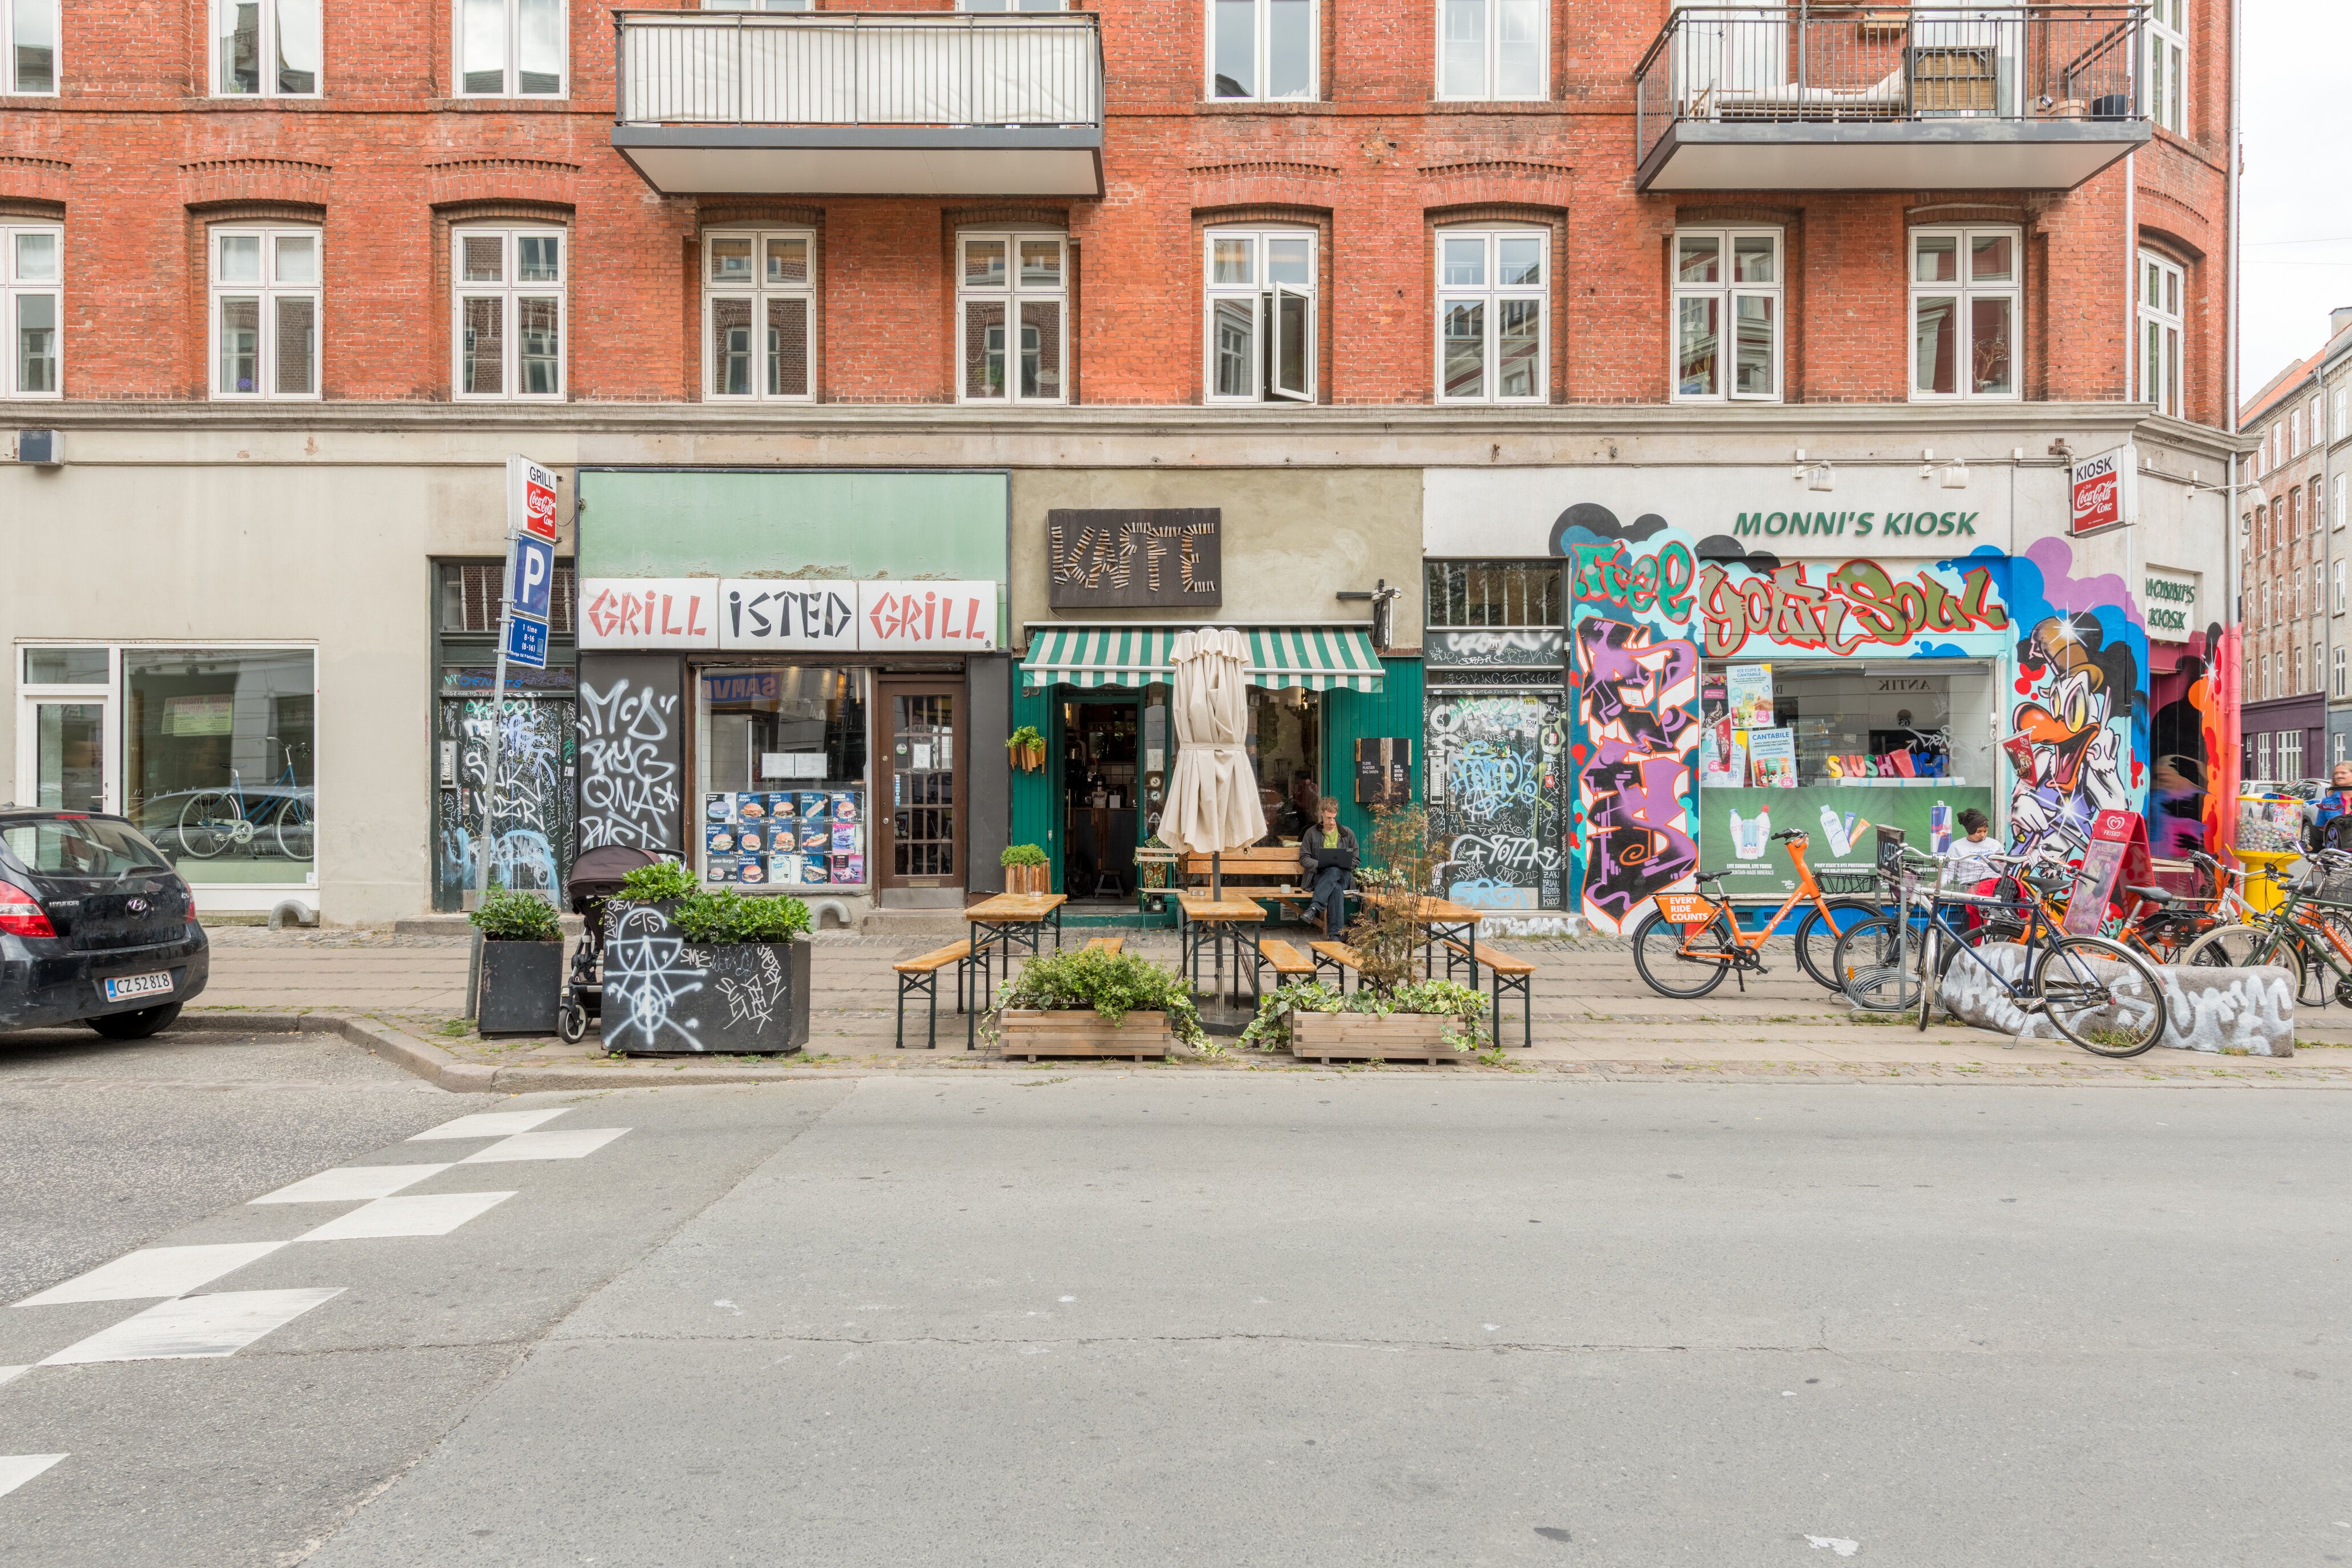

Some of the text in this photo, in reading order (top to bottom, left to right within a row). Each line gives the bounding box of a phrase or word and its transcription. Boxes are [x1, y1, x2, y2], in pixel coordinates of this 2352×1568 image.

[530, 466, 553, 490] GRILL
[2076, 456, 2113, 482] KIOSK
[529, 490, 553, 516] Coca-Cola
[2077, 480, 2112, 509] Coca-Cola
[2097, 502, 2113, 514] Coke
[543, 515, 553, 527] Coke
[1733, 511, 1979, 536] MONNI'S KIOSK
[1051, 522, 1216, 593] KAFFE
[522, 545, 545, 604] P
[527, 625, 537, 633] time
[2149, 608, 2186, 630] KIOSK
[522, 642, 535, 652] (8-16)
[1752, 732, 1790, 741] CANTABILE
[1827, 754, 1895, 778] SLUSH
[2096, 845, 2119, 854] MAGNUM
[1786, 891, 1803, 910] REPUBLIC
[2326, 928, 2341, 944] DONKEY
[116, 977, 131, 994] CZ
[135, 976, 149, 991] 52
[151, 973, 170, 990] 818
